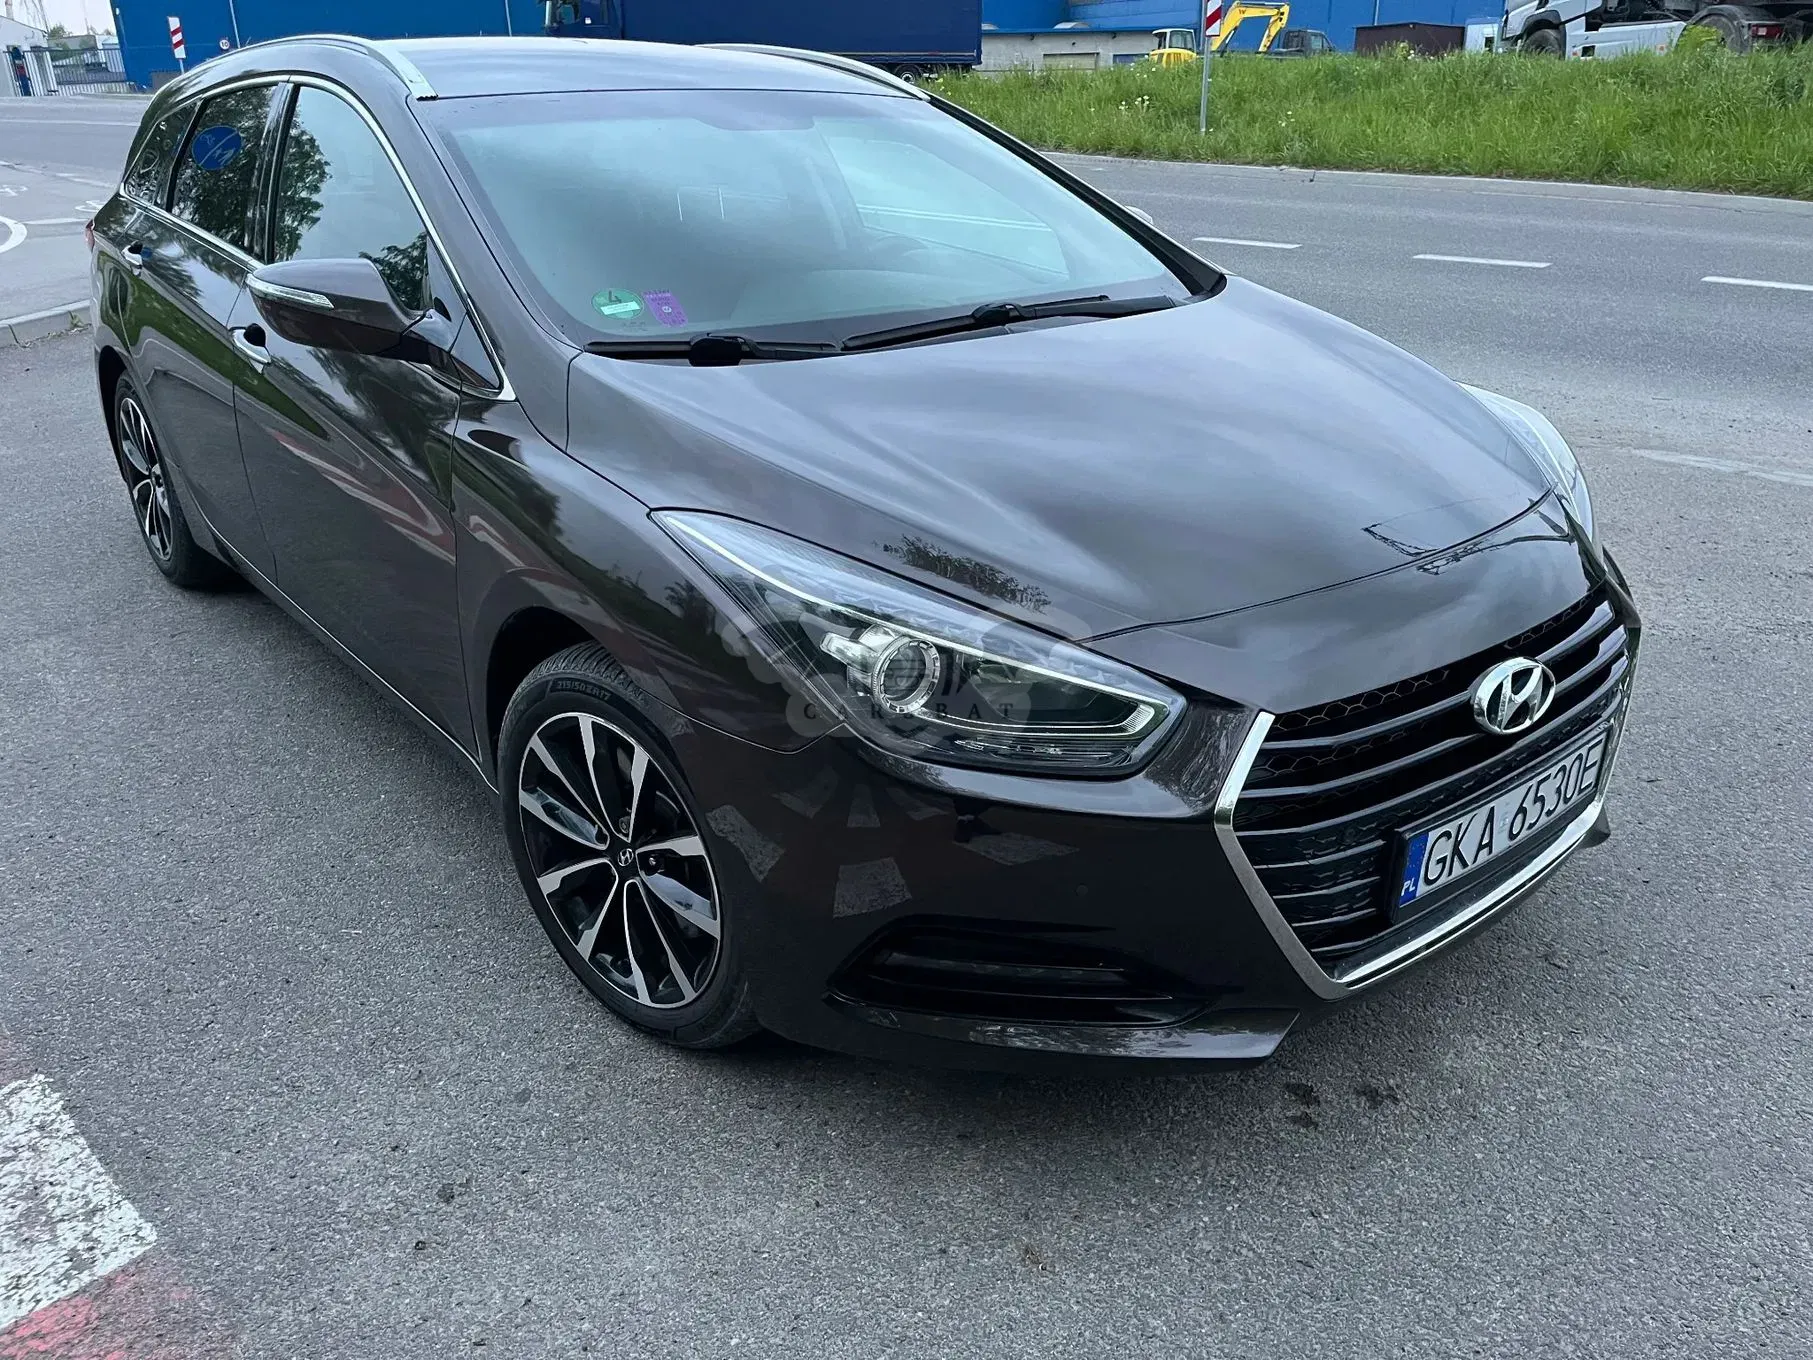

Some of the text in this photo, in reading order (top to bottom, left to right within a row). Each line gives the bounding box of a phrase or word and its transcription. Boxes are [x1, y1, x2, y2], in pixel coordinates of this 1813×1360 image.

[1423, 738, 1604, 886] GKA 6530E
[1400, 879, 1416, 896] PL
